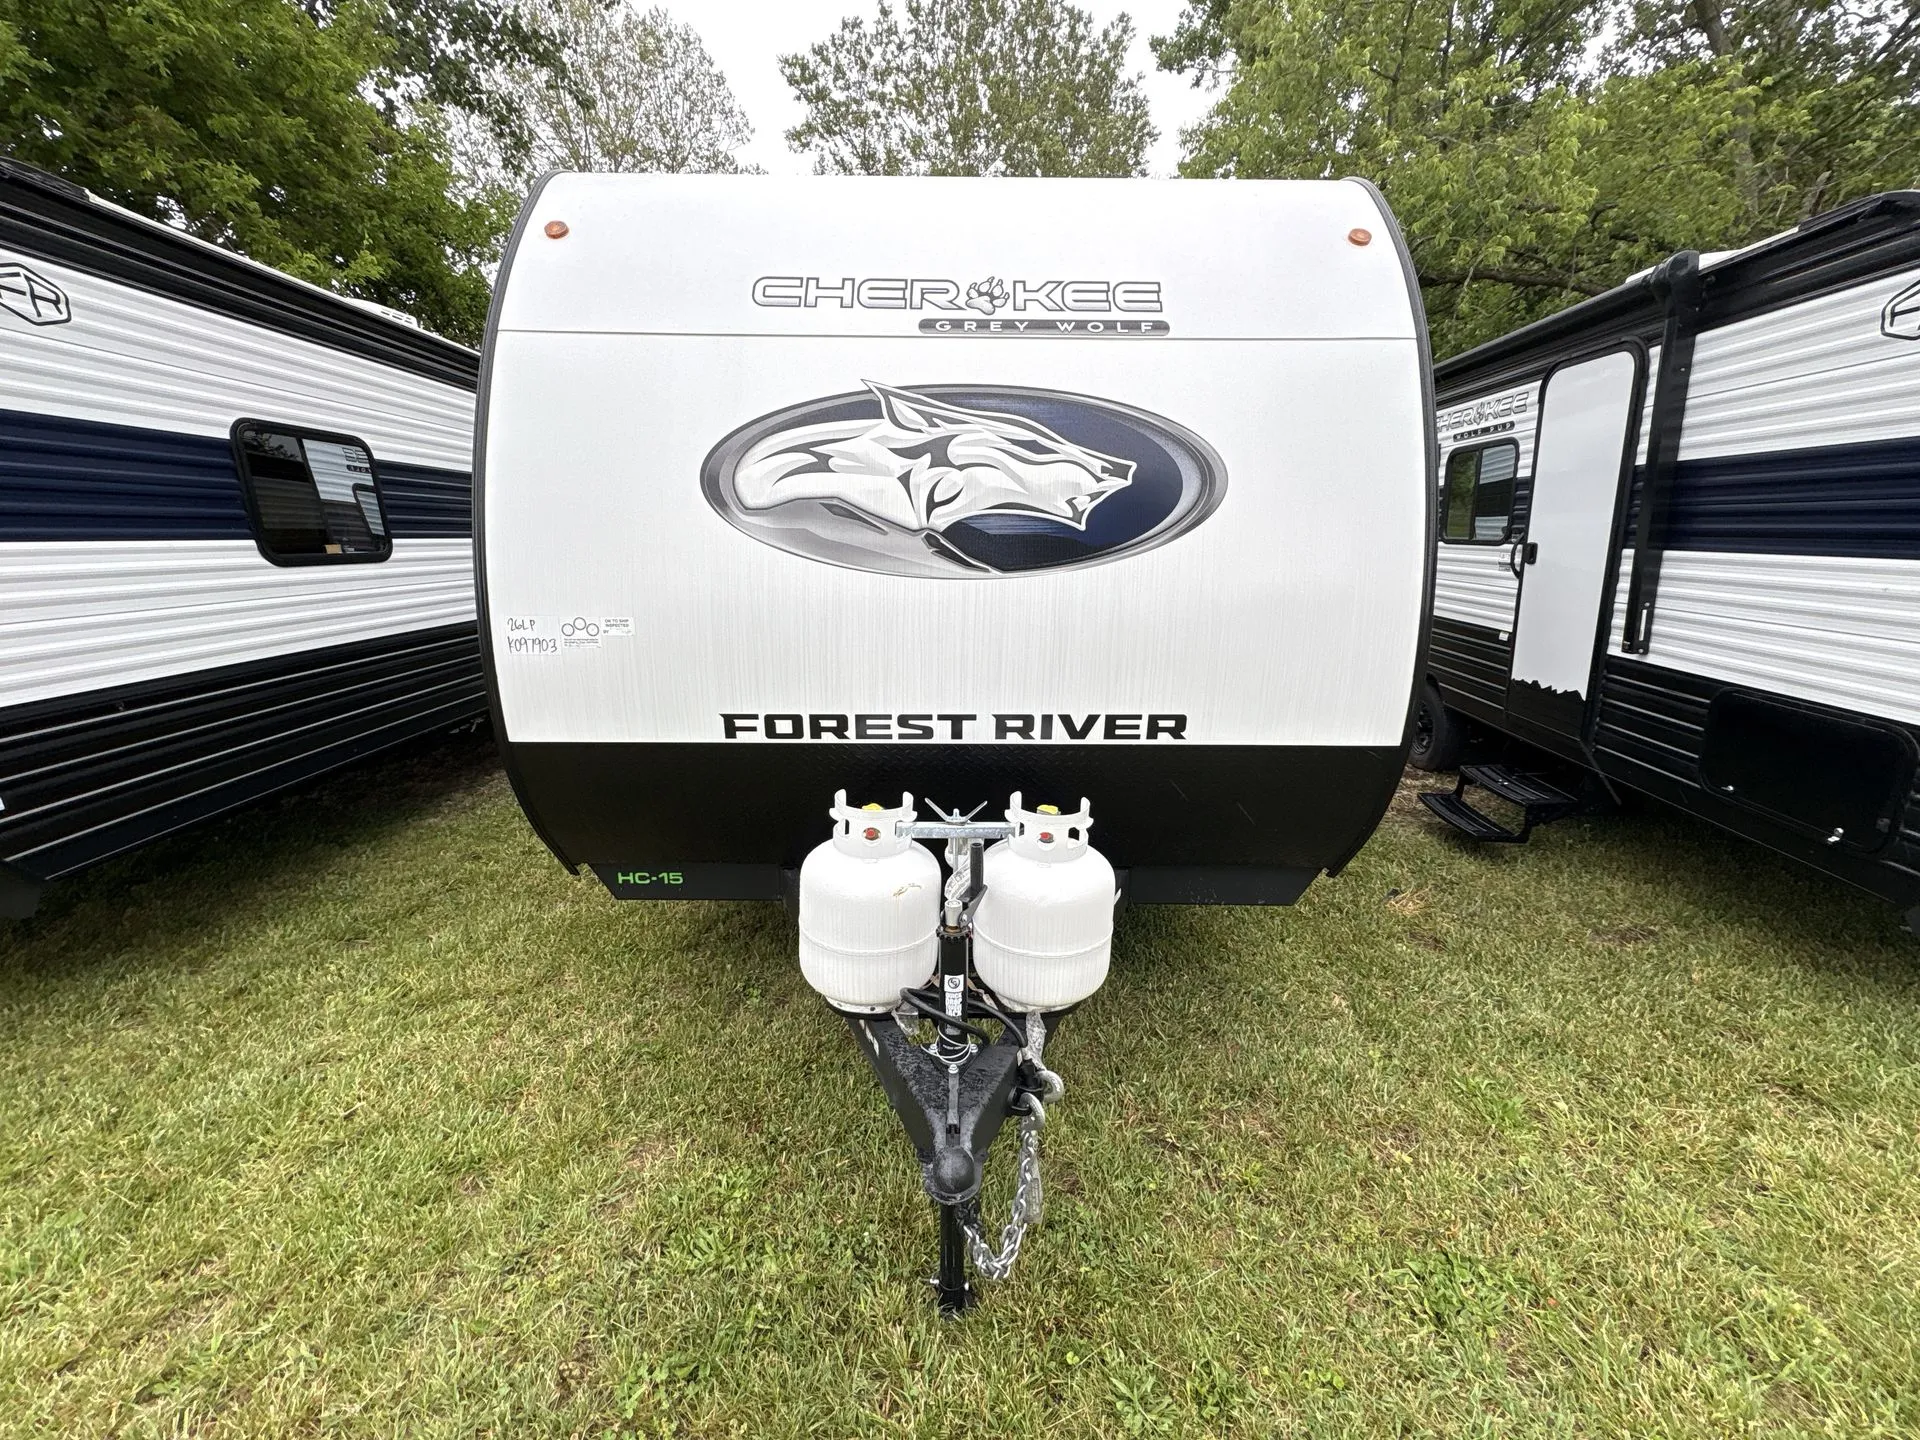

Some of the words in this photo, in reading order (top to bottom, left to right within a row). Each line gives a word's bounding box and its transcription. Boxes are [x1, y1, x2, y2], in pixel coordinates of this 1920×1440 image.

[935, 321, 1029, 332] GREY
[1056, 321, 1154, 334] WOLF
[1436, 392, 1530, 432] HEROKEE
[1456, 429, 1482, 440] WOLF
[1489, 422, 1512, 433] PUP
[718, 713, 977, 740] FOREST
[991, 713, 1188, 741] RIVER
[617, 872, 684, 885] HC-15
